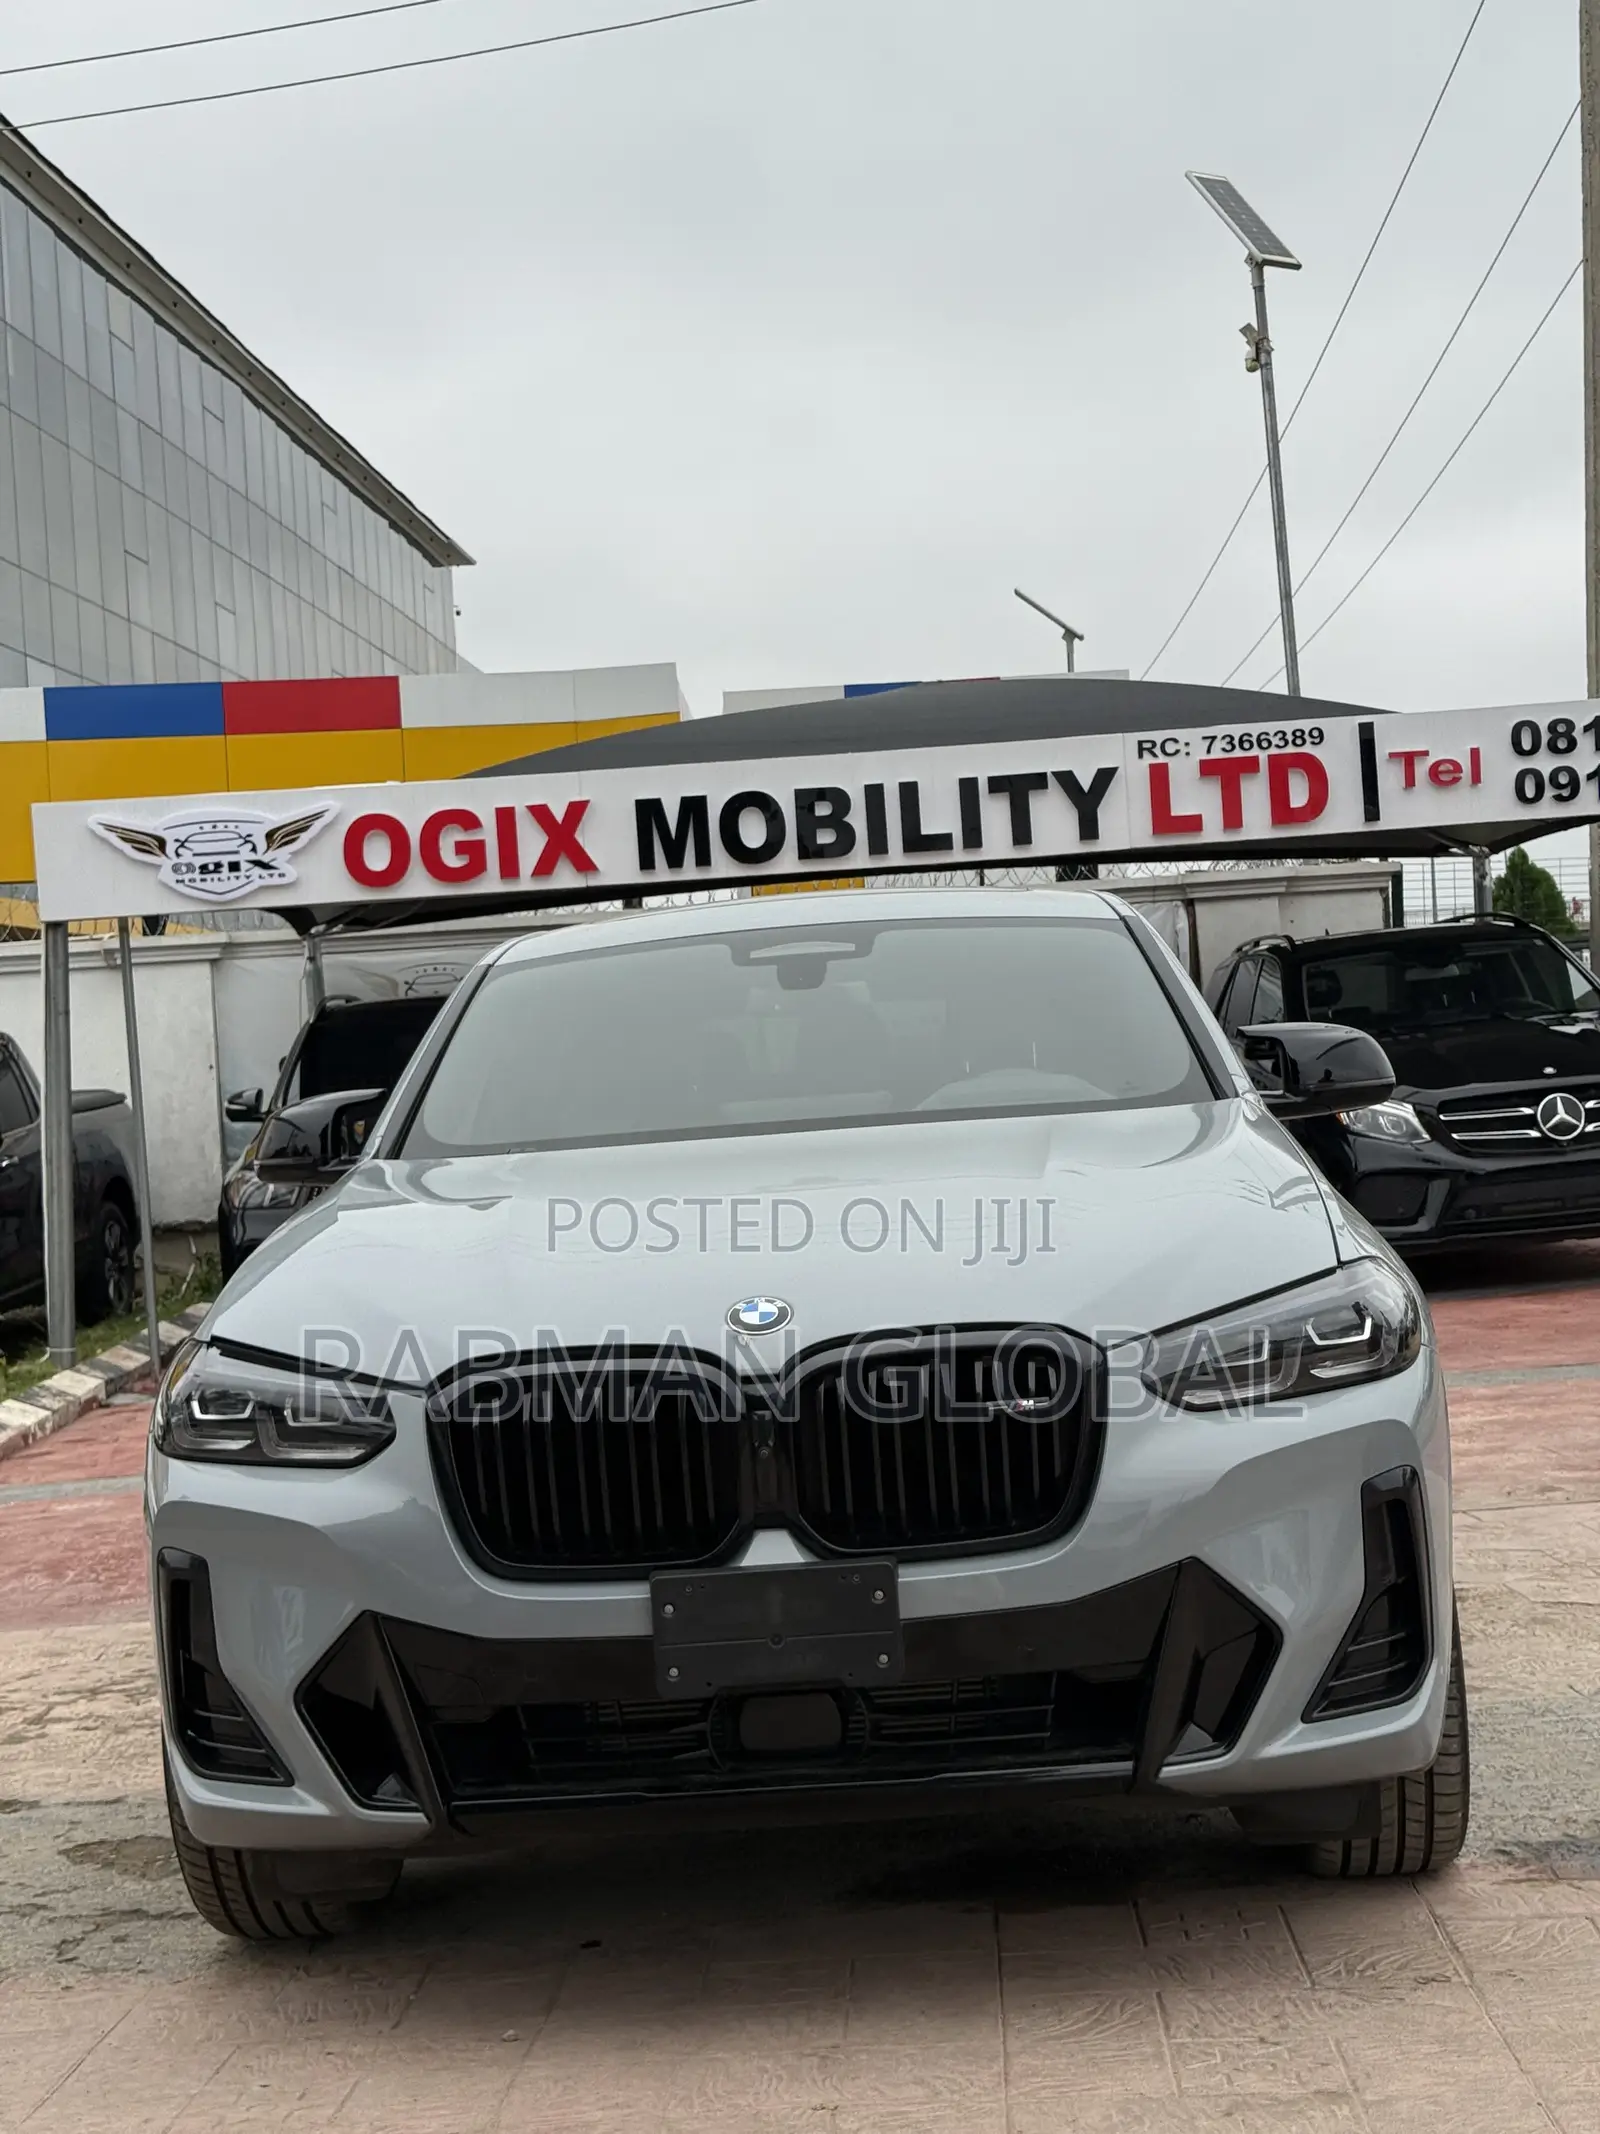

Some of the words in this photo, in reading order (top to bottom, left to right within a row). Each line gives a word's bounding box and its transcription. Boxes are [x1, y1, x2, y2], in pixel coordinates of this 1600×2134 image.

[1137, 736, 1191, 760] RC:
[1201, 726, 1325, 755] 7366389
[342, 799, 600, 888] OGIX
[634, 765, 1120, 872] MOBILITY
[1148, 751, 1330, 835] LTD
[1388, 746, 1482, 789] Tel
